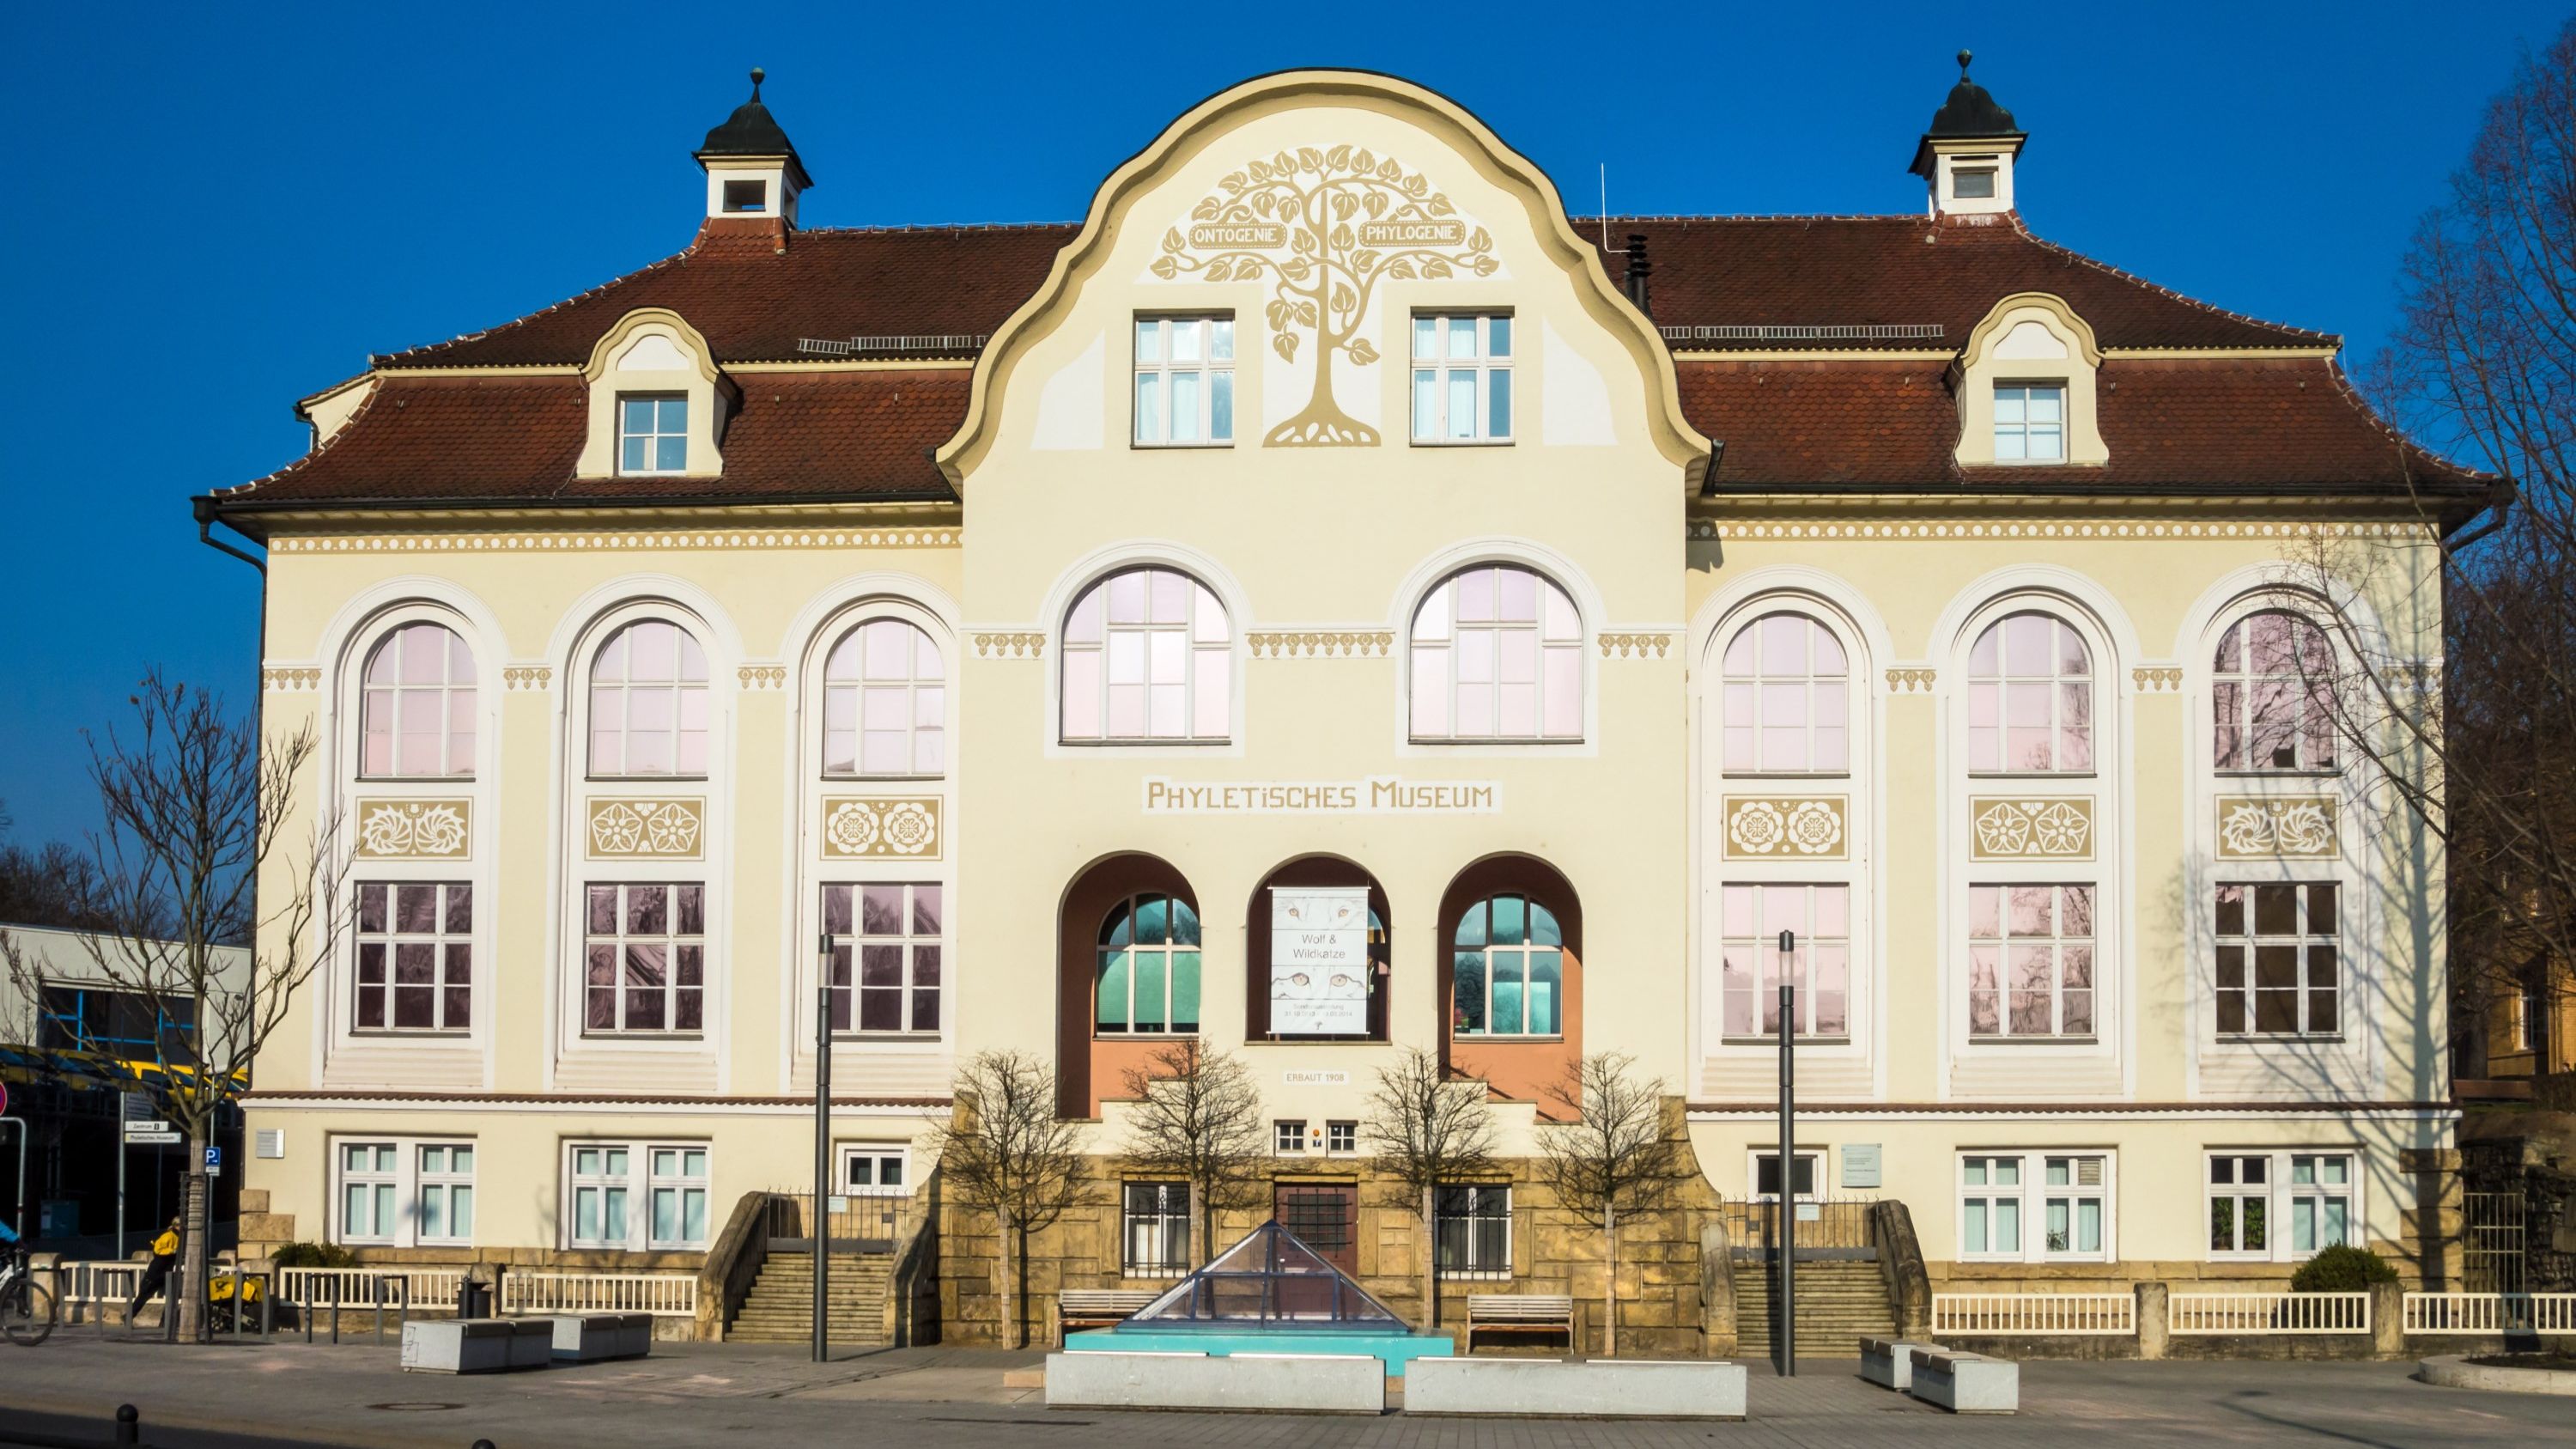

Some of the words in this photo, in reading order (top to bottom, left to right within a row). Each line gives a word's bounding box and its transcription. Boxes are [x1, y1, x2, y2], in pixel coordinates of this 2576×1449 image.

[1147, 782, 1357, 809] PHYLETiSCHES
[1371, 781, 1492, 808] MUSEUM
[1302, 934, 1326, 945] Wolf
[1329, 935, 1337, 944] &
[1293, 948, 1346, 959] Wildkatze
[1286, 1074, 1322, 1082] ERBAUT
[1326, 1074, 1345, 1082] 1908
[206, 1149, 216, 1163] P
